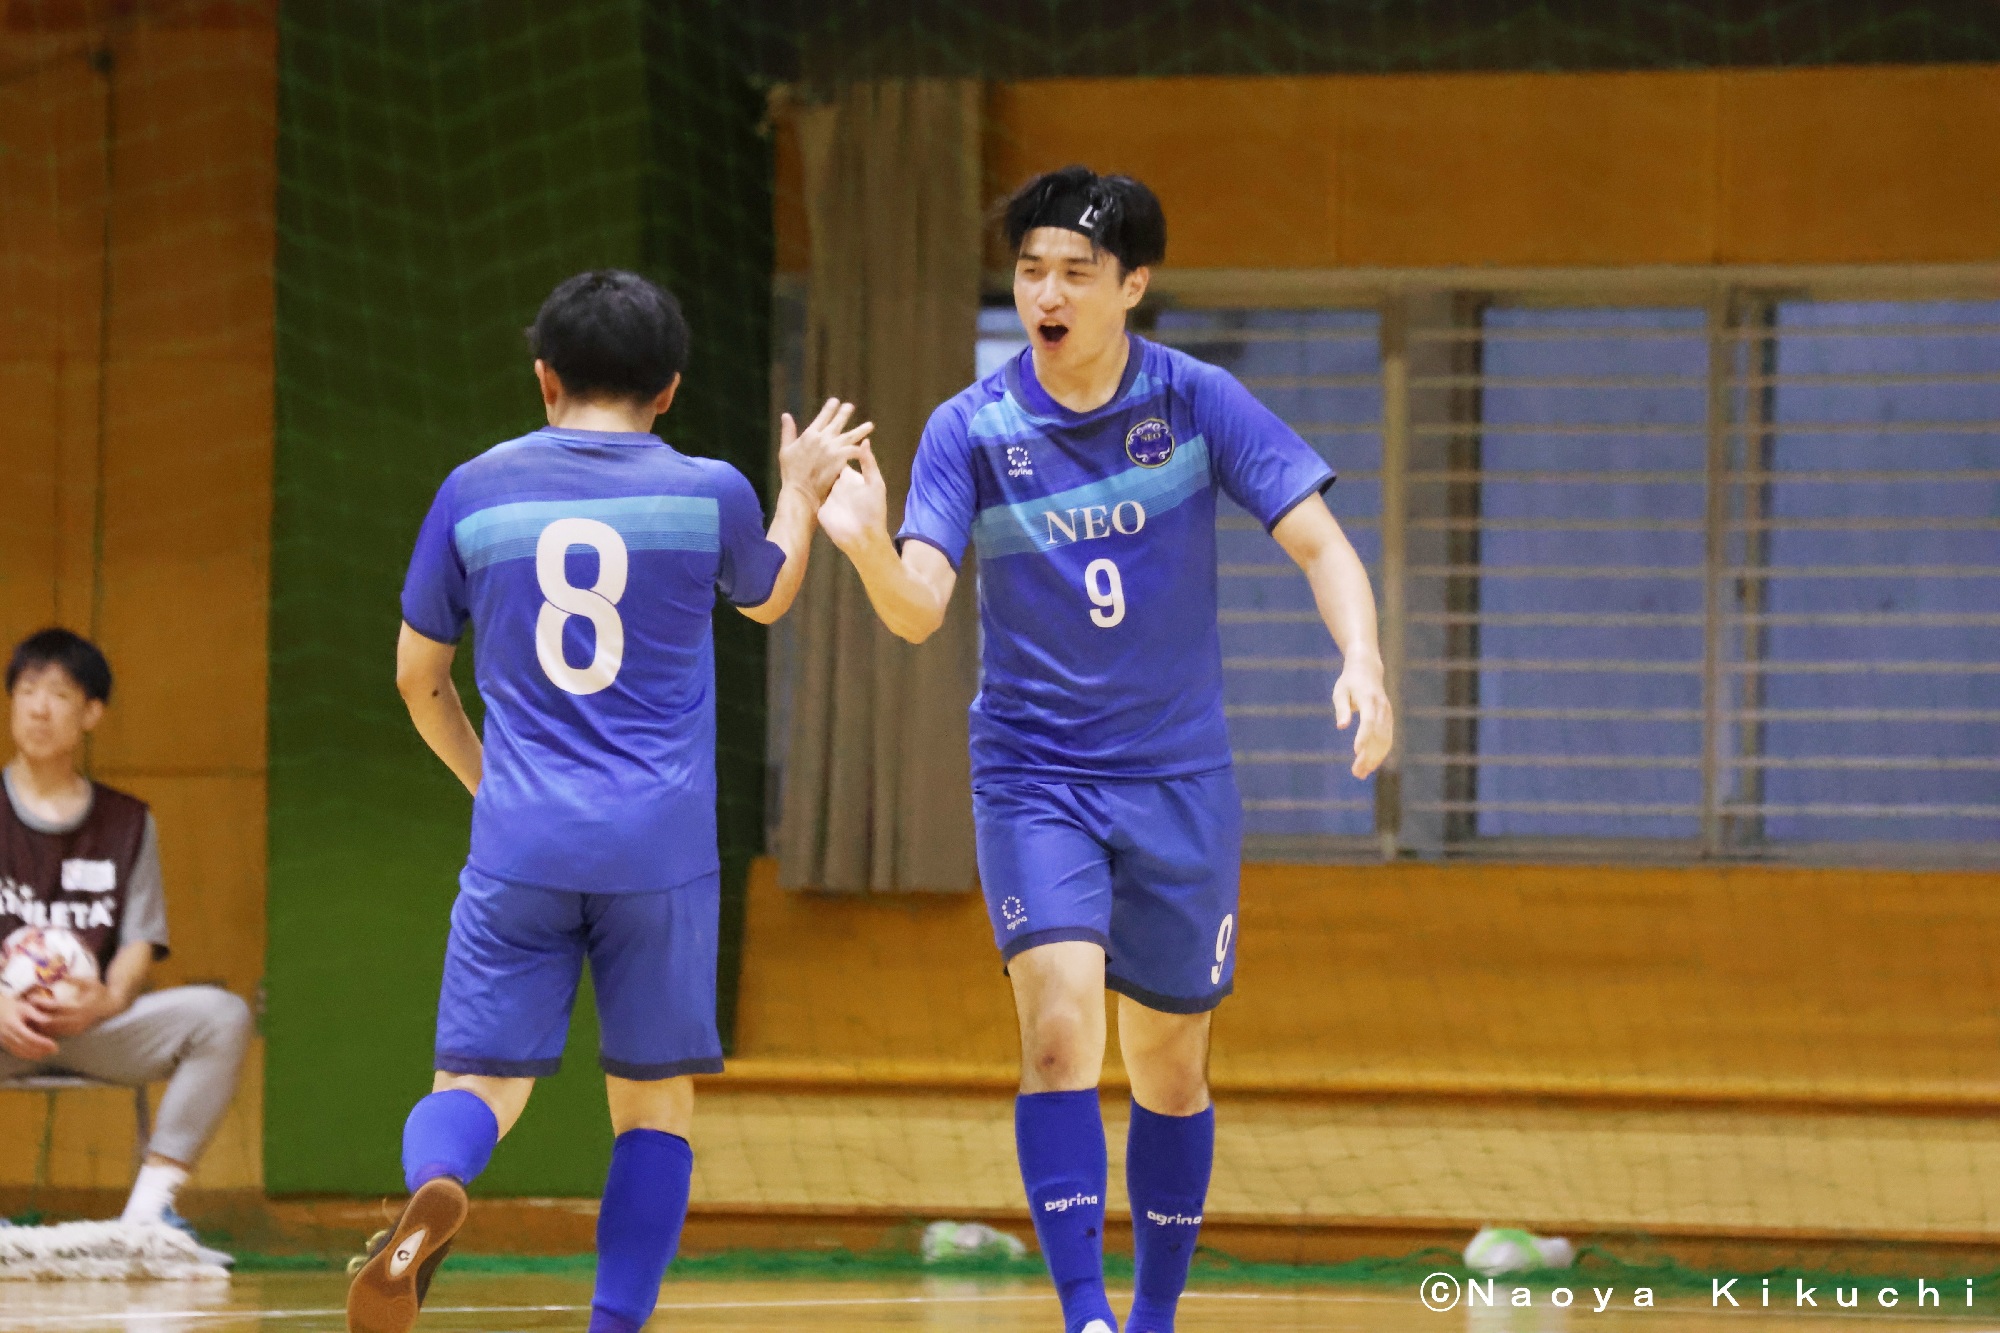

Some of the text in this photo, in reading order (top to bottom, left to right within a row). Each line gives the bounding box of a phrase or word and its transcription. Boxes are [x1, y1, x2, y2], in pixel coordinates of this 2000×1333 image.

[1008, 467, 1033, 478] agrina
[1043, 500, 1146, 545] NEO
[535, 517, 628, 696] 8
[1084, 558, 1126, 628] 9
[1211, 913, 1233, 985] 9
[1044, 1192, 1098, 1212] agrina
[1147, 1210, 1203, 1226] agrina
